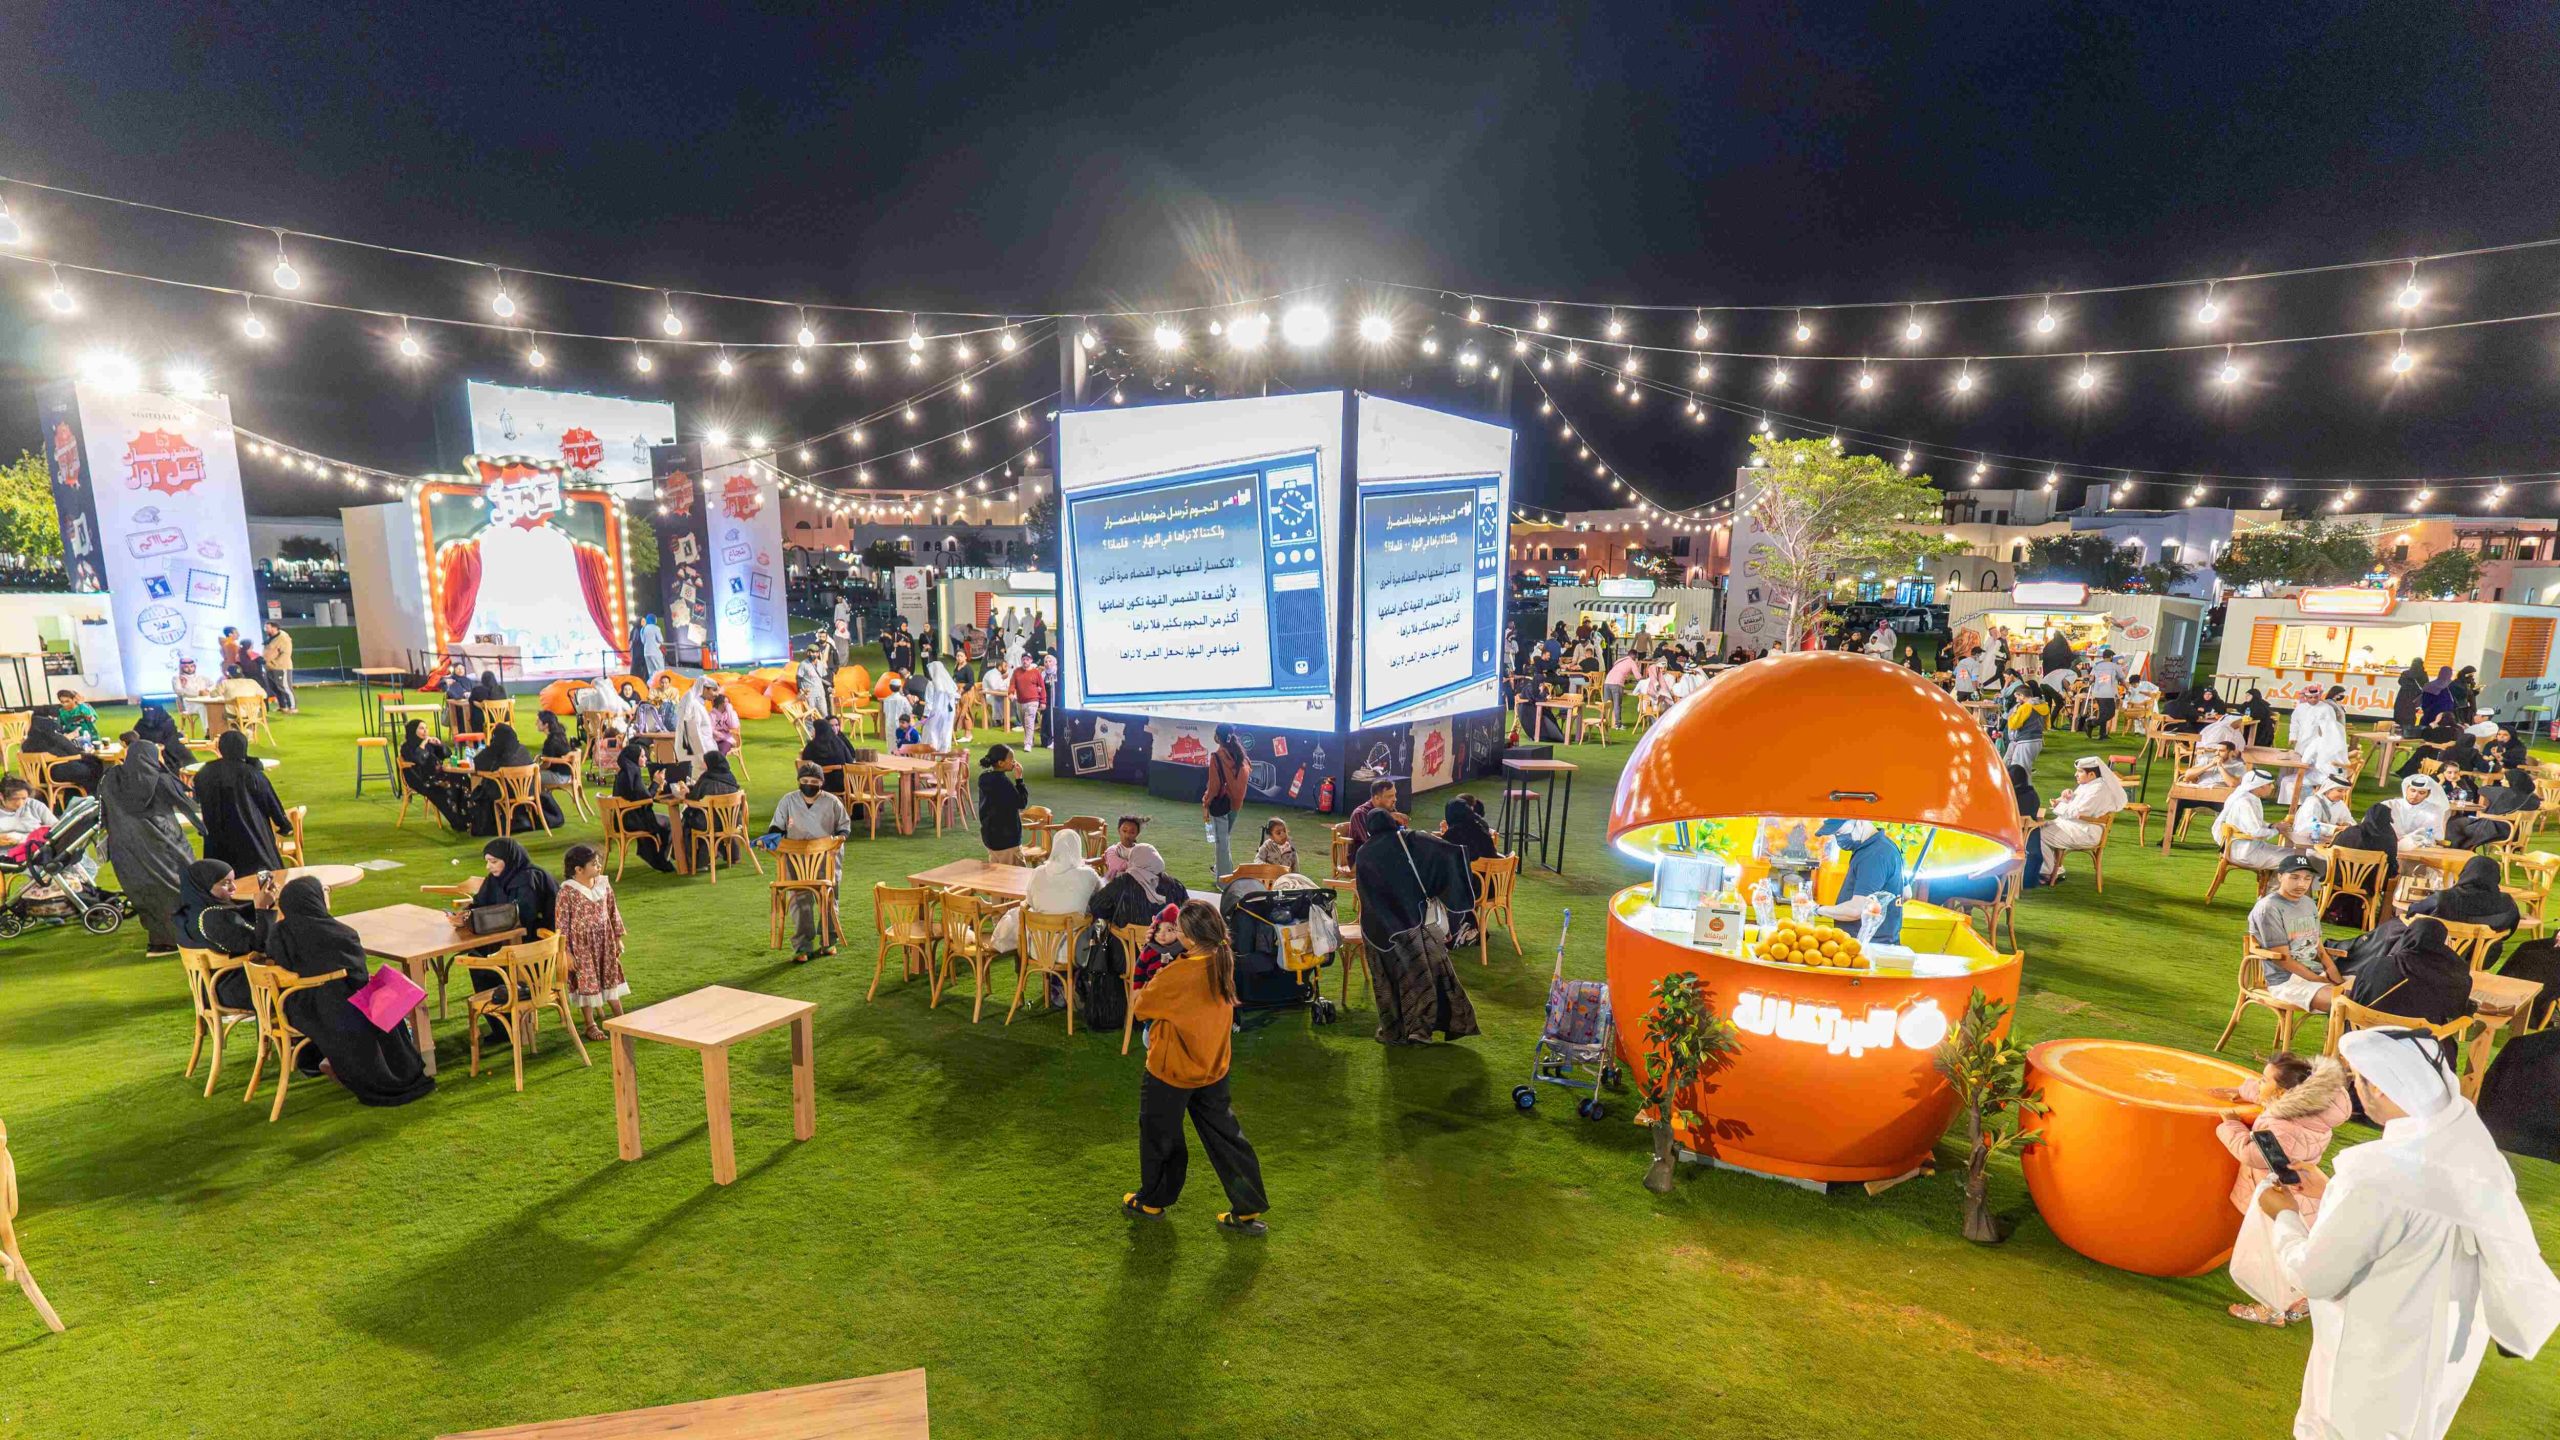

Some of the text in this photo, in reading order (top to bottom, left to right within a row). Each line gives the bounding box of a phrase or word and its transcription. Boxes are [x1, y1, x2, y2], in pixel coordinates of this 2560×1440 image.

[1116, 571, 1129, 583] مرة
[1130, 566, 1155, 580] الفضاء
[1157, 567, 1172, 579] نحو
[1170, 591, 1200, 606] الشمس
[1201, 585, 1224, 600] أشعة
[1226, 584, 1237, 602] لأن
[1183, 615, 1208, 630] النجوم
[1210, 619, 1221, 628] من
[1223, 609, 1239, 627] أكثر
